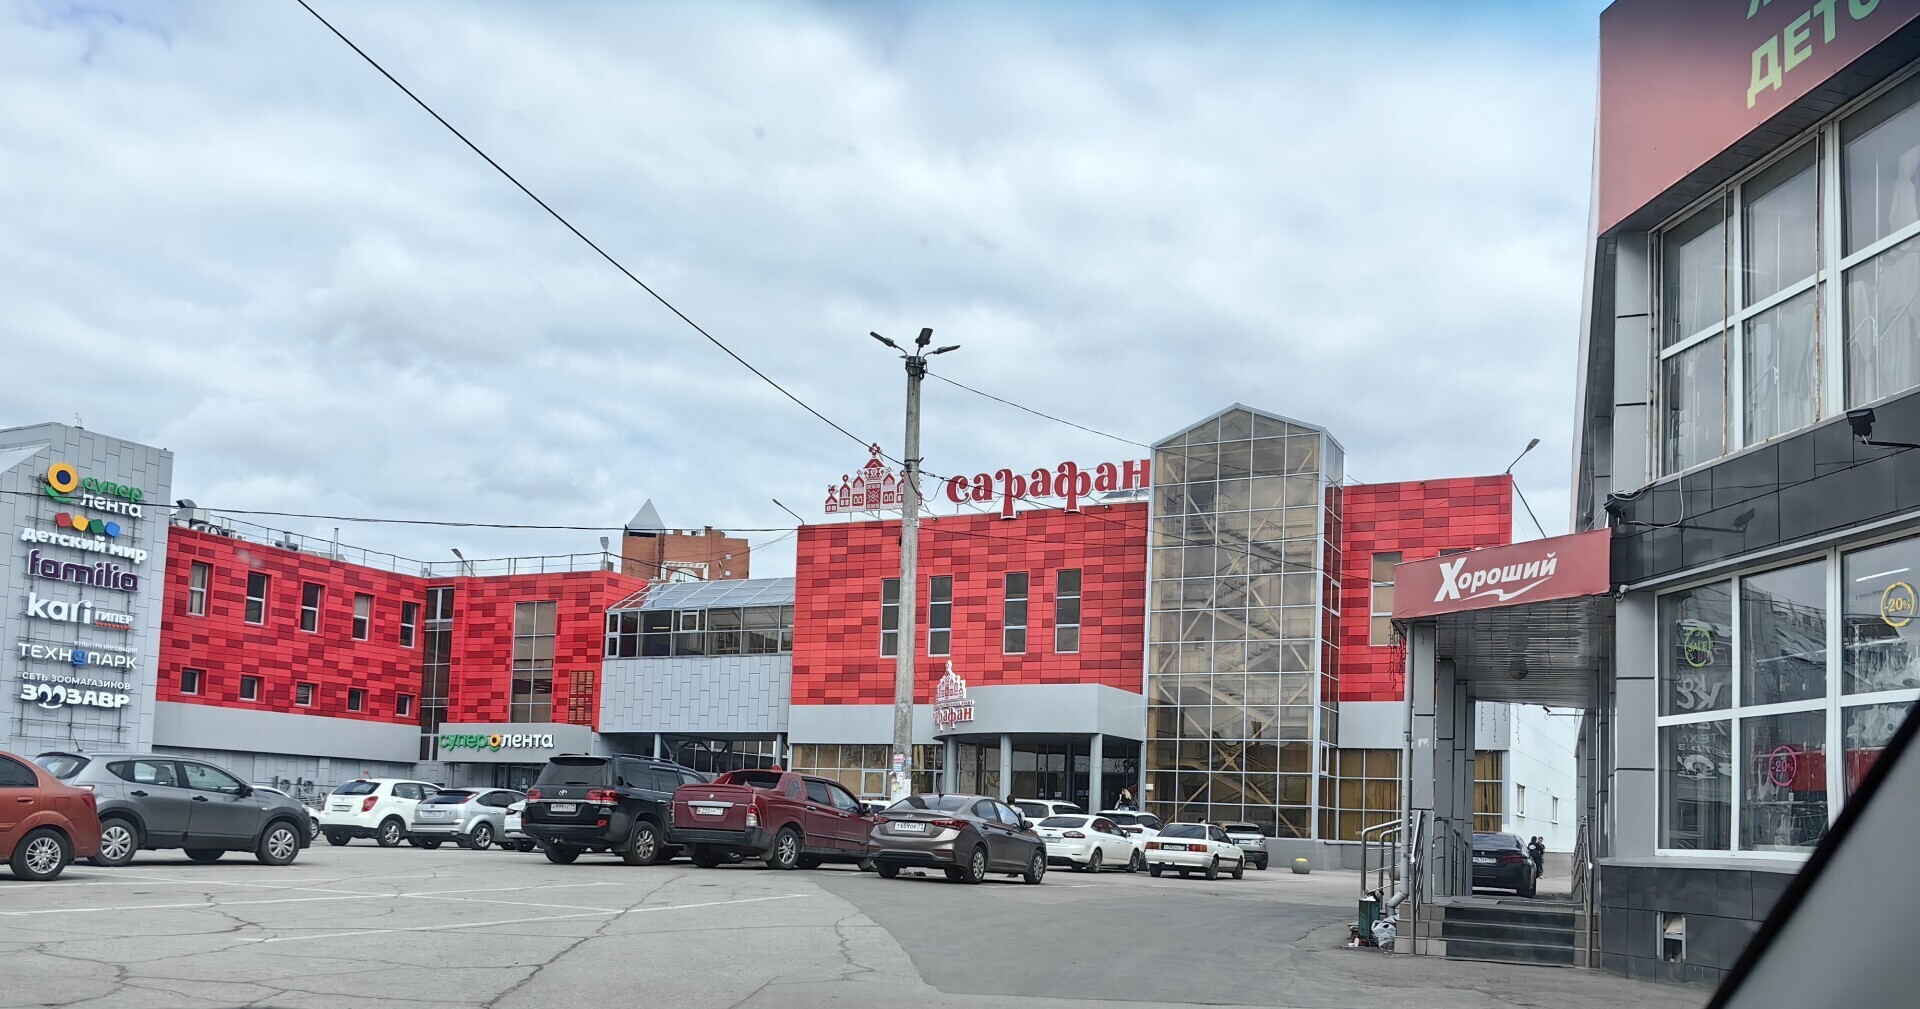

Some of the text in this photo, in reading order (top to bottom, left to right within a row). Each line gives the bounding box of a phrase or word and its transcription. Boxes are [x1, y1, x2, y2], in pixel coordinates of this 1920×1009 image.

[82, 477, 144, 502] супер
[947, 458, 1150, 520] сарафан
[80, 493, 142, 518] лента
[21, 528, 147, 564] детский мир
[28, 548, 138, 592] familia
[1433, 552, 1557, 602] Хороший
[28, 592, 133, 624] kari ГИПЕР
[22, 671, 131, 690] СЕТЬ ЗООМАГАЗИНОВ
[20, 683, 130, 708] ЗООЗАВР
[438, 733, 553, 751] супер лента
